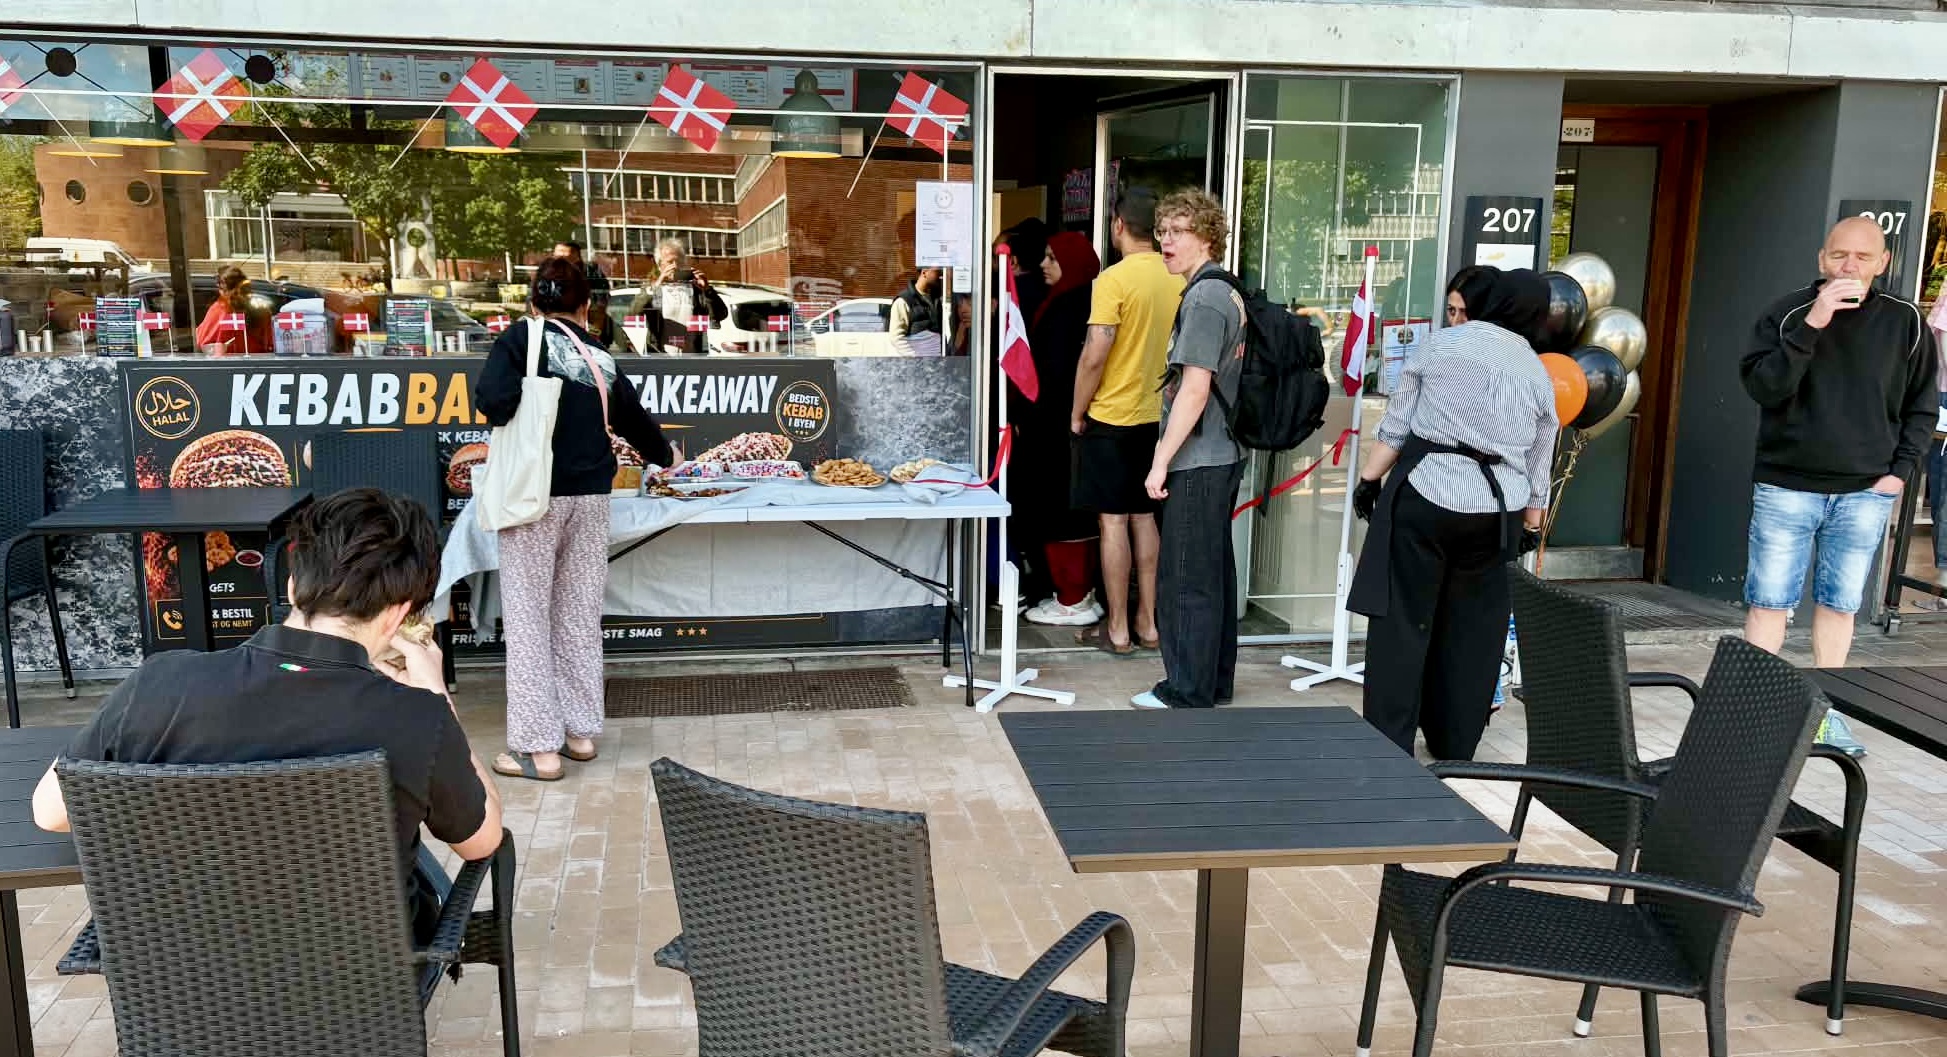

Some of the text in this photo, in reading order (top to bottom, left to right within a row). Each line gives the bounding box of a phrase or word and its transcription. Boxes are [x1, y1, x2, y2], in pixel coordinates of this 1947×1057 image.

[1482, 207, 1535, 232] 207
[1859, 211, 1907, 235] 07
[145, 389, 191, 416] حلال
[229, 372, 487, 425] KEBABBA
[789, 393, 820, 406] BEDSTE
[783, 403, 824, 420] KEBAB
[152, 411, 190, 427] HALAL
[789, 417, 815, 429] I BYEN
[212, 608, 254, 619] & BESTIL
[220, 620, 230, 628] OG
[452, 633, 497, 645] FRIE
[628, 628, 662, 638] SMAG
